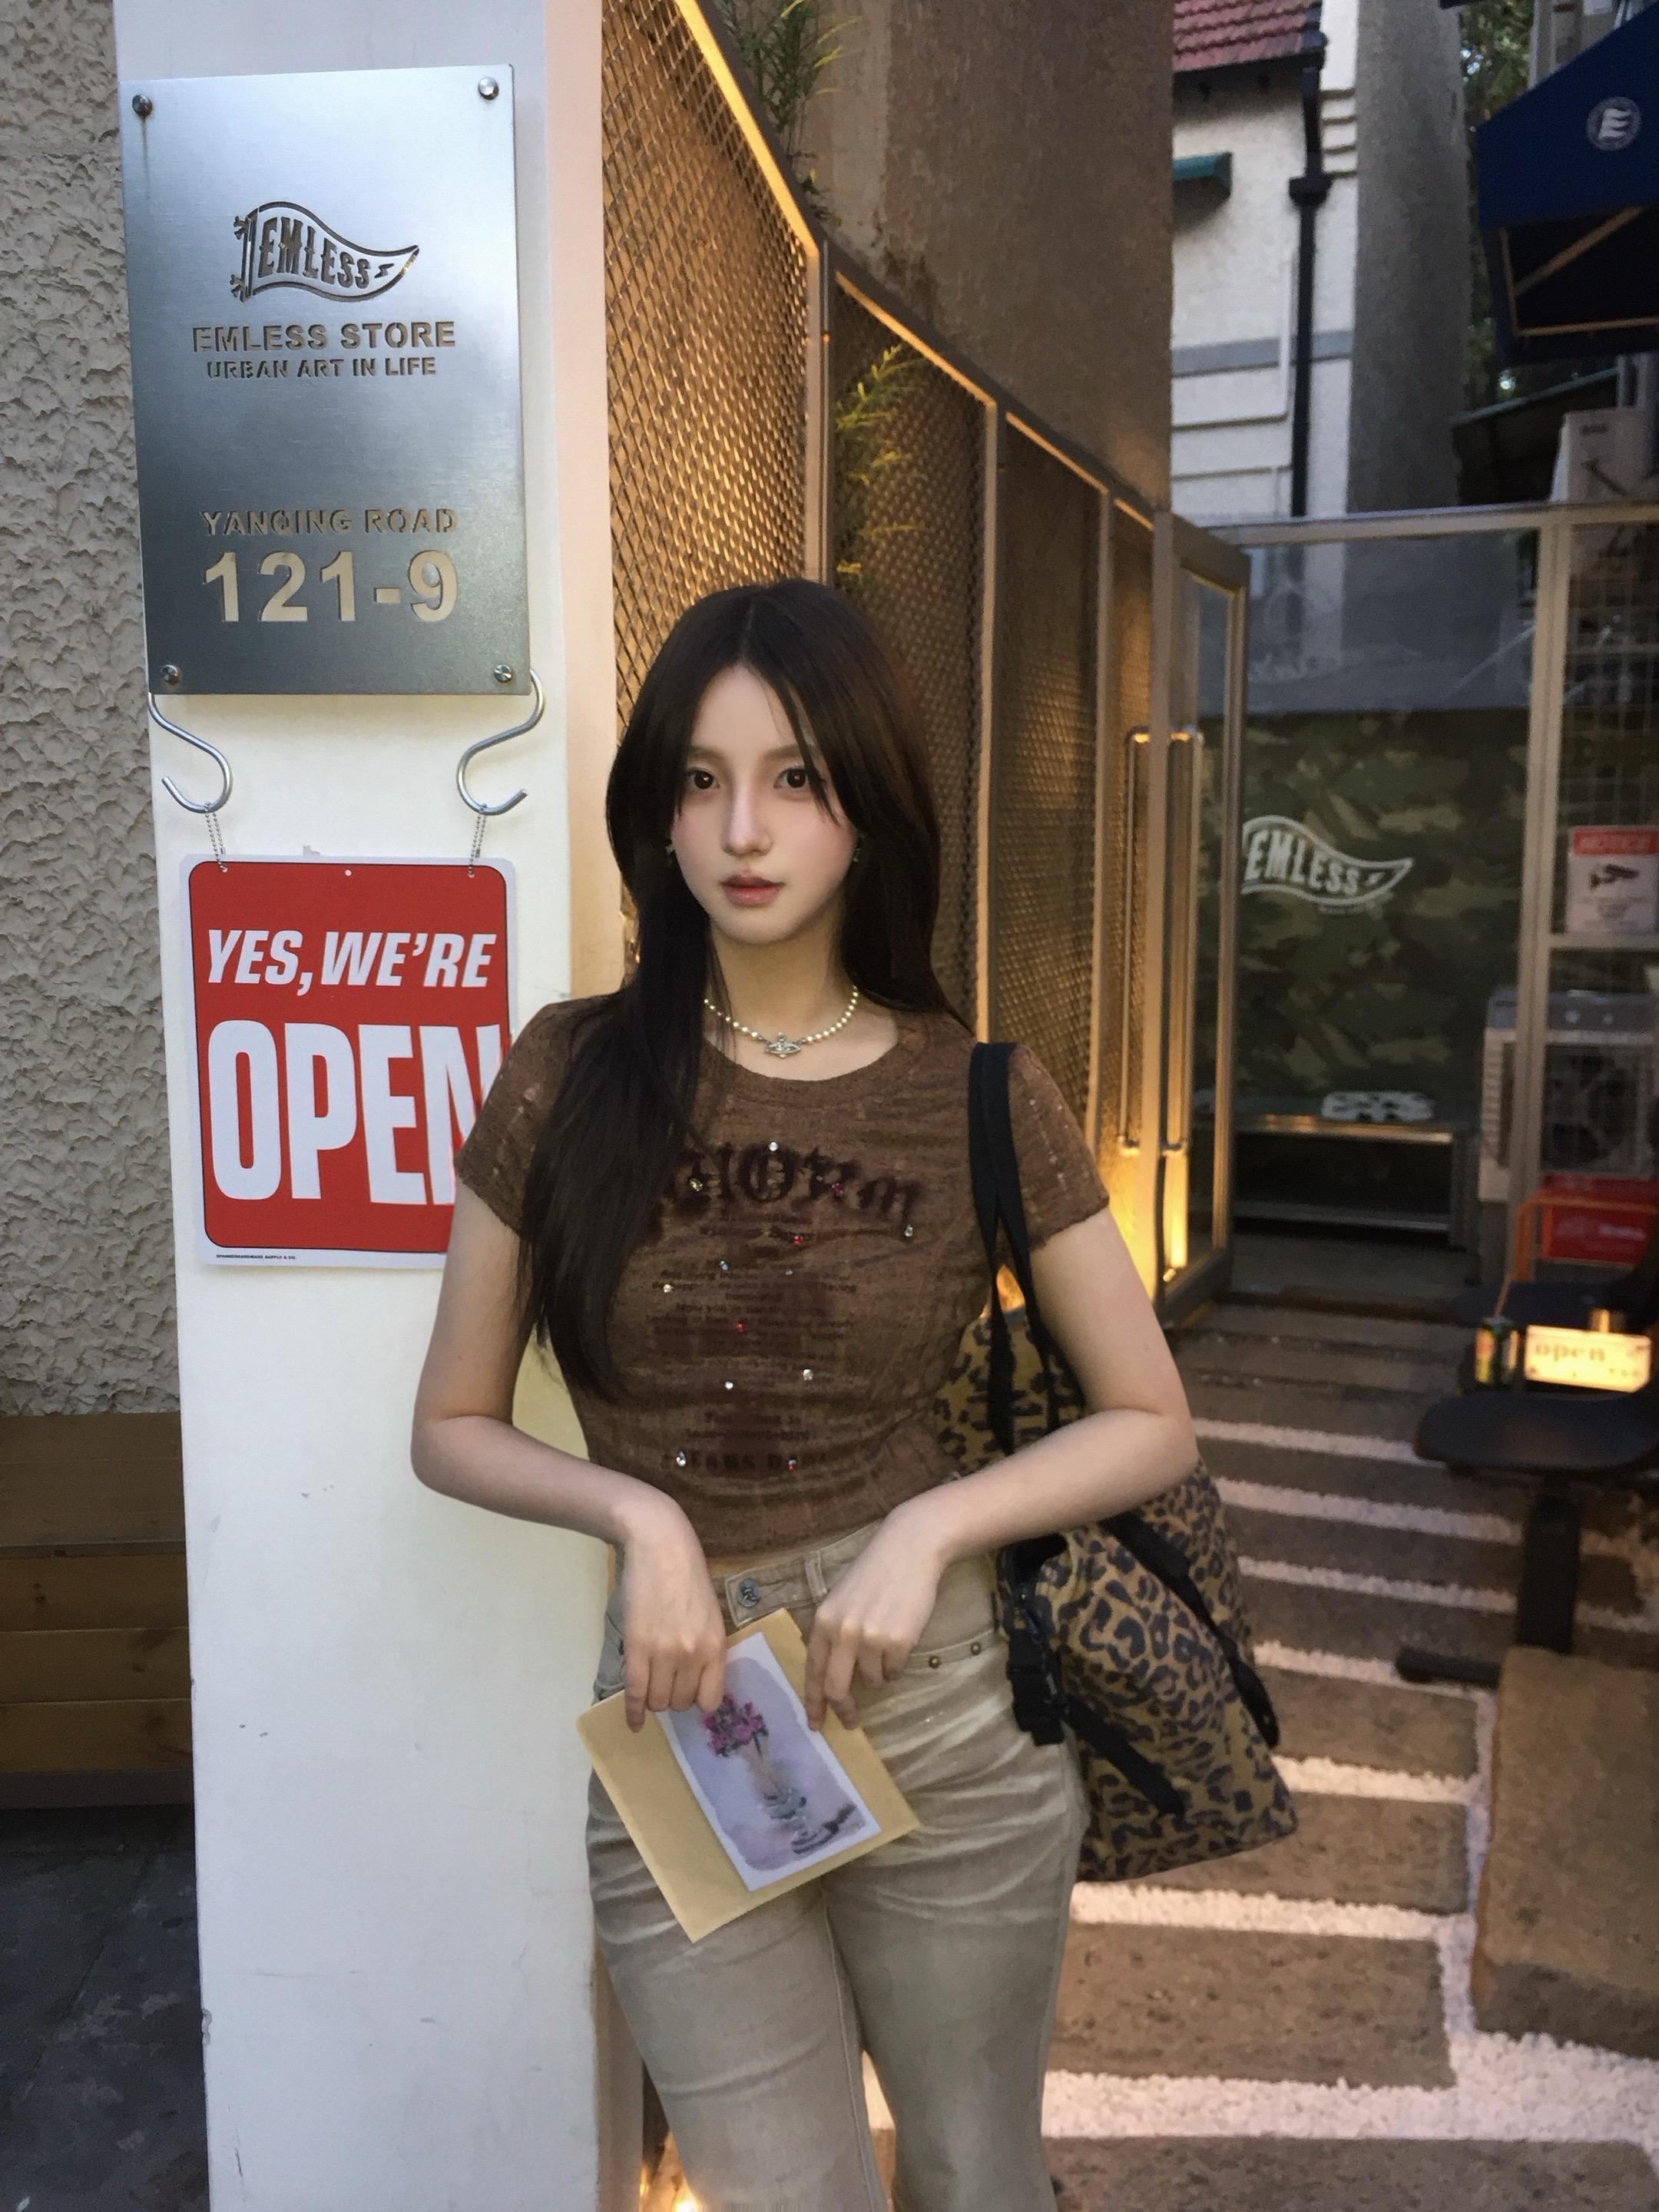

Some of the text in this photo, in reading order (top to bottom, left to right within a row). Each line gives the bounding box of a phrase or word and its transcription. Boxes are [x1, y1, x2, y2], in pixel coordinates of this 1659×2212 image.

[257, 216, 370, 290] EMLESS
[192, 321, 455, 353] EMLESS STORE
[207, 356, 436, 379] URBAN ART IN LIFE
[200, 508, 457, 536] YANQING ROAD
[203, 549, 459, 622] 121-9
[1244, 830, 1359, 896] EMLESS
[207, 1019, 501, 1205] OPEN
